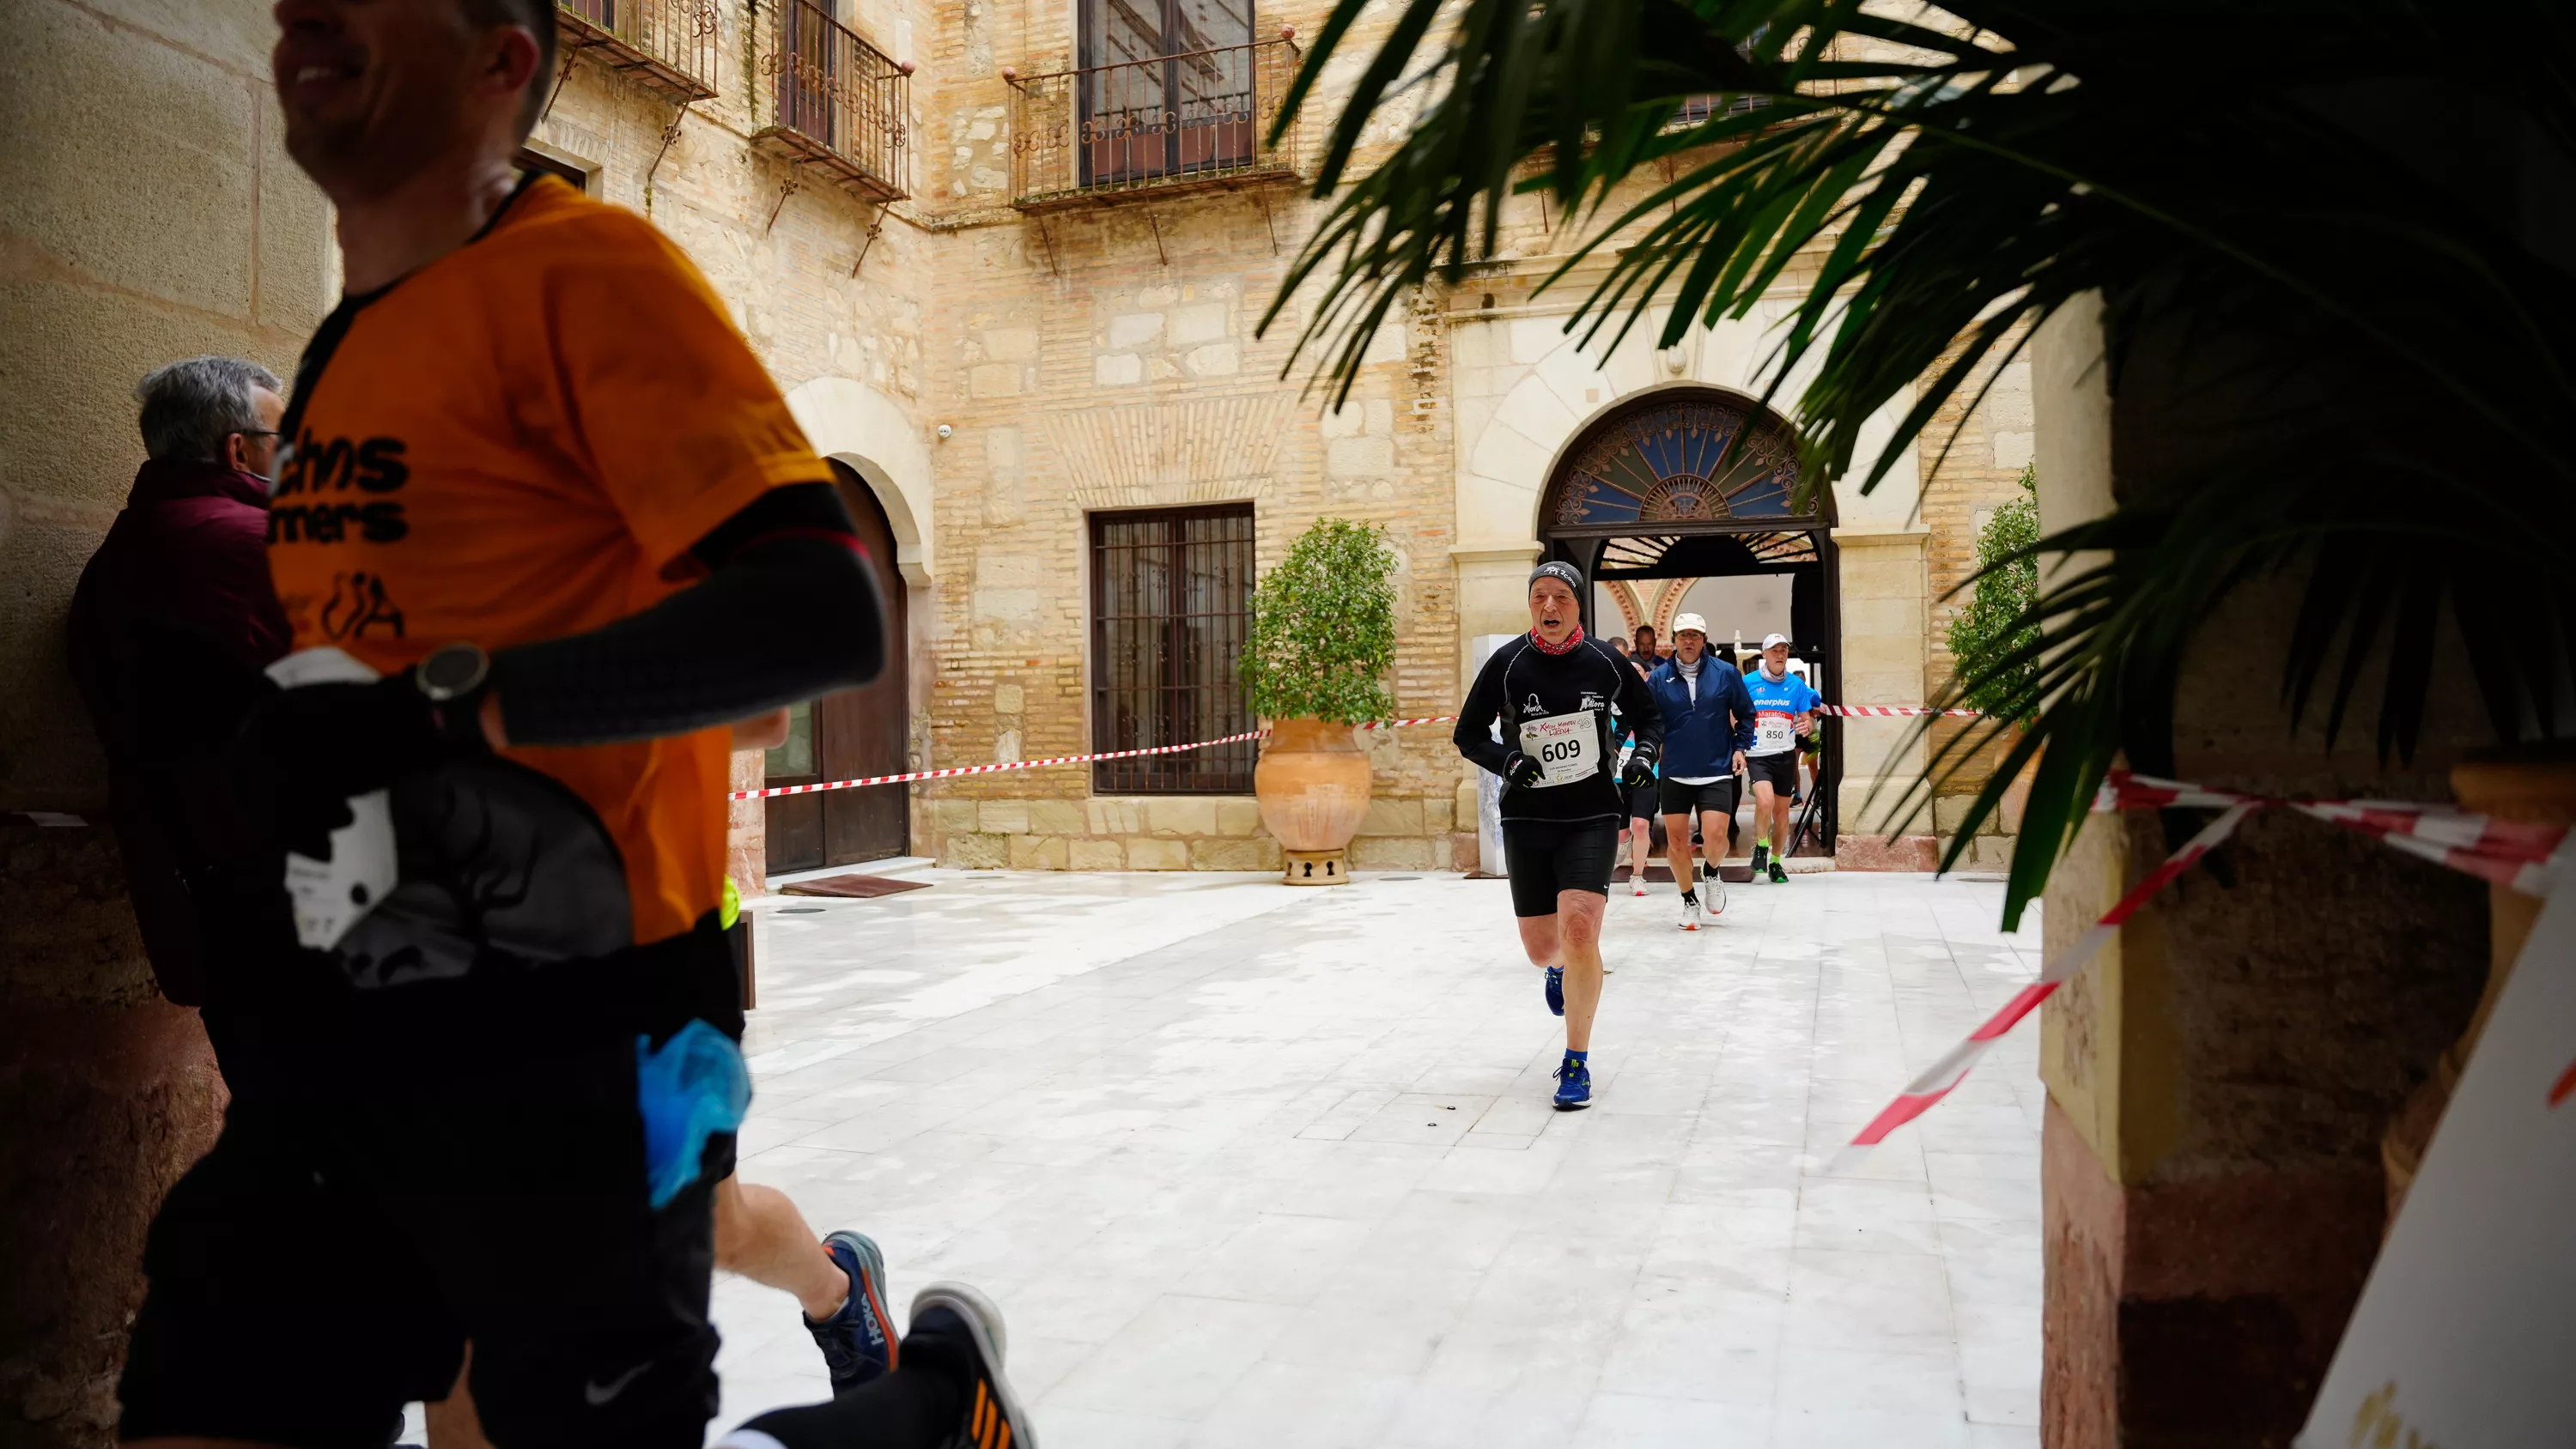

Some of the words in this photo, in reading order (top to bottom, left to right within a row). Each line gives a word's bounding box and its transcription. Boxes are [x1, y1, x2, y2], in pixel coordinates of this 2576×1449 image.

[1753, 699, 1791, 707] enerplus
[1765, 730, 1783, 739] 850
[1542, 739, 1581, 763] 609
[861, 1292, 885, 1345] HOKA
